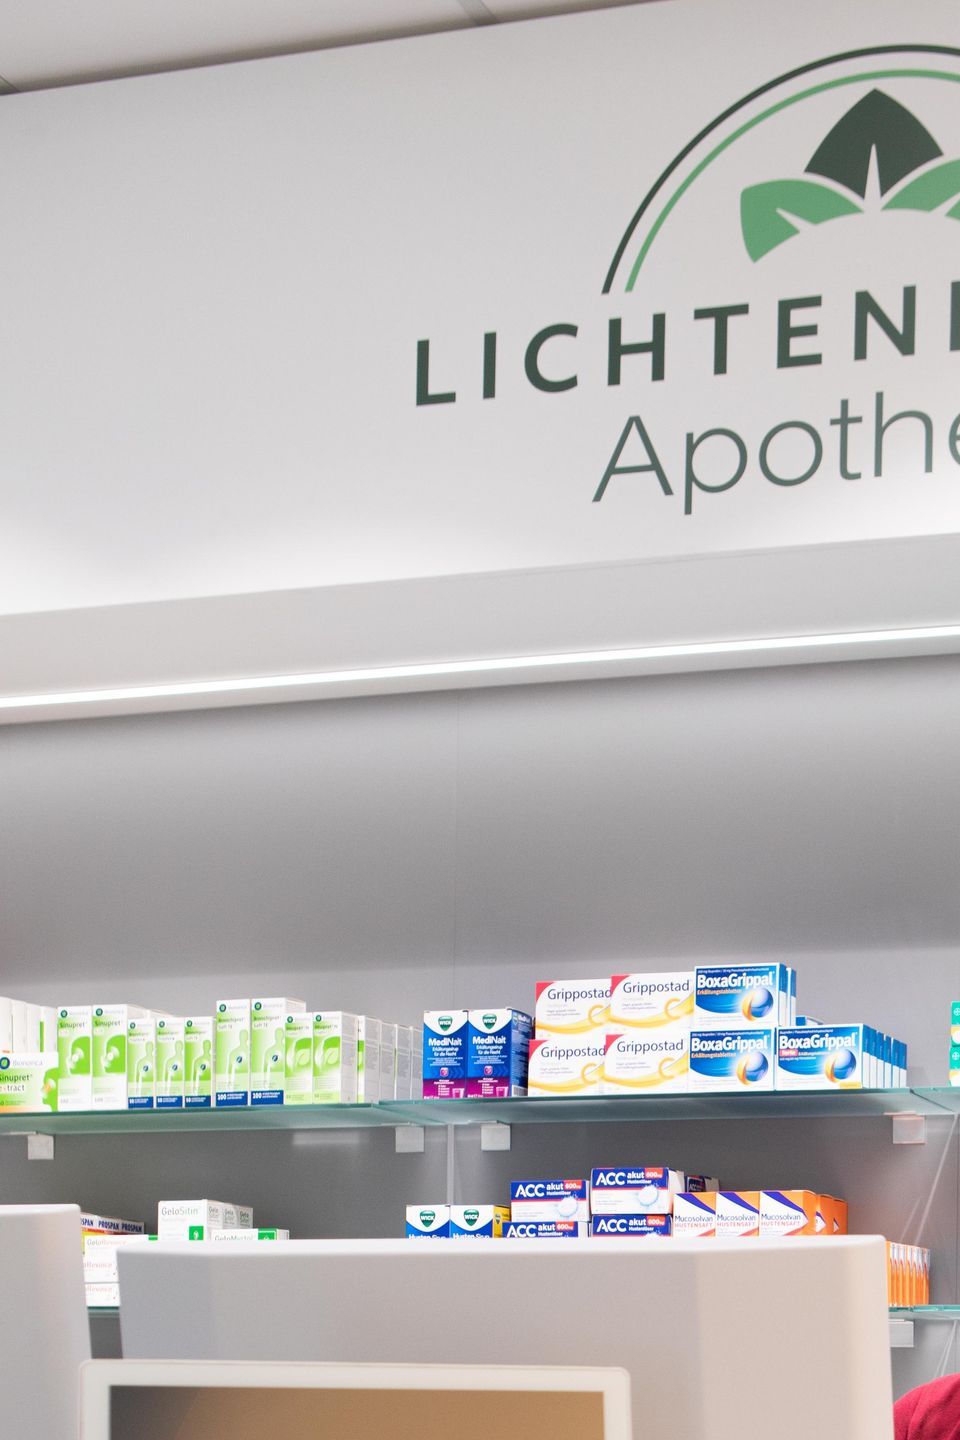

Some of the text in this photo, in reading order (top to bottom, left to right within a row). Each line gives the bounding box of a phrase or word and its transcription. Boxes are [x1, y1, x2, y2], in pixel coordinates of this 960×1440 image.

[697, 972, 772, 989] BoxaGrippal
[623, 980, 689, 996] Grippostad
[428, 1037, 462, 1046] MediNait
[472, 1036, 506, 1044] MediNait
[617, 1040, 683, 1054] Grippostad
[691, 1035, 768, 1052] BoxaGrippal
[780, 1032, 856, 1050] BoxaGrippal
[596, 1172, 626, 1185] ACC
[627, 1171, 644, 1179] akut
[515, 1184, 545, 1198] ACC
[99, 1220, 119, 1230] PROSPAN
[121, 1223, 142, 1232] PROSPAN
[507, 1224, 537, 1238] ACC
[596, 1219, 627, 1232] ACC
[629, 1218, 646, 1226] akut
